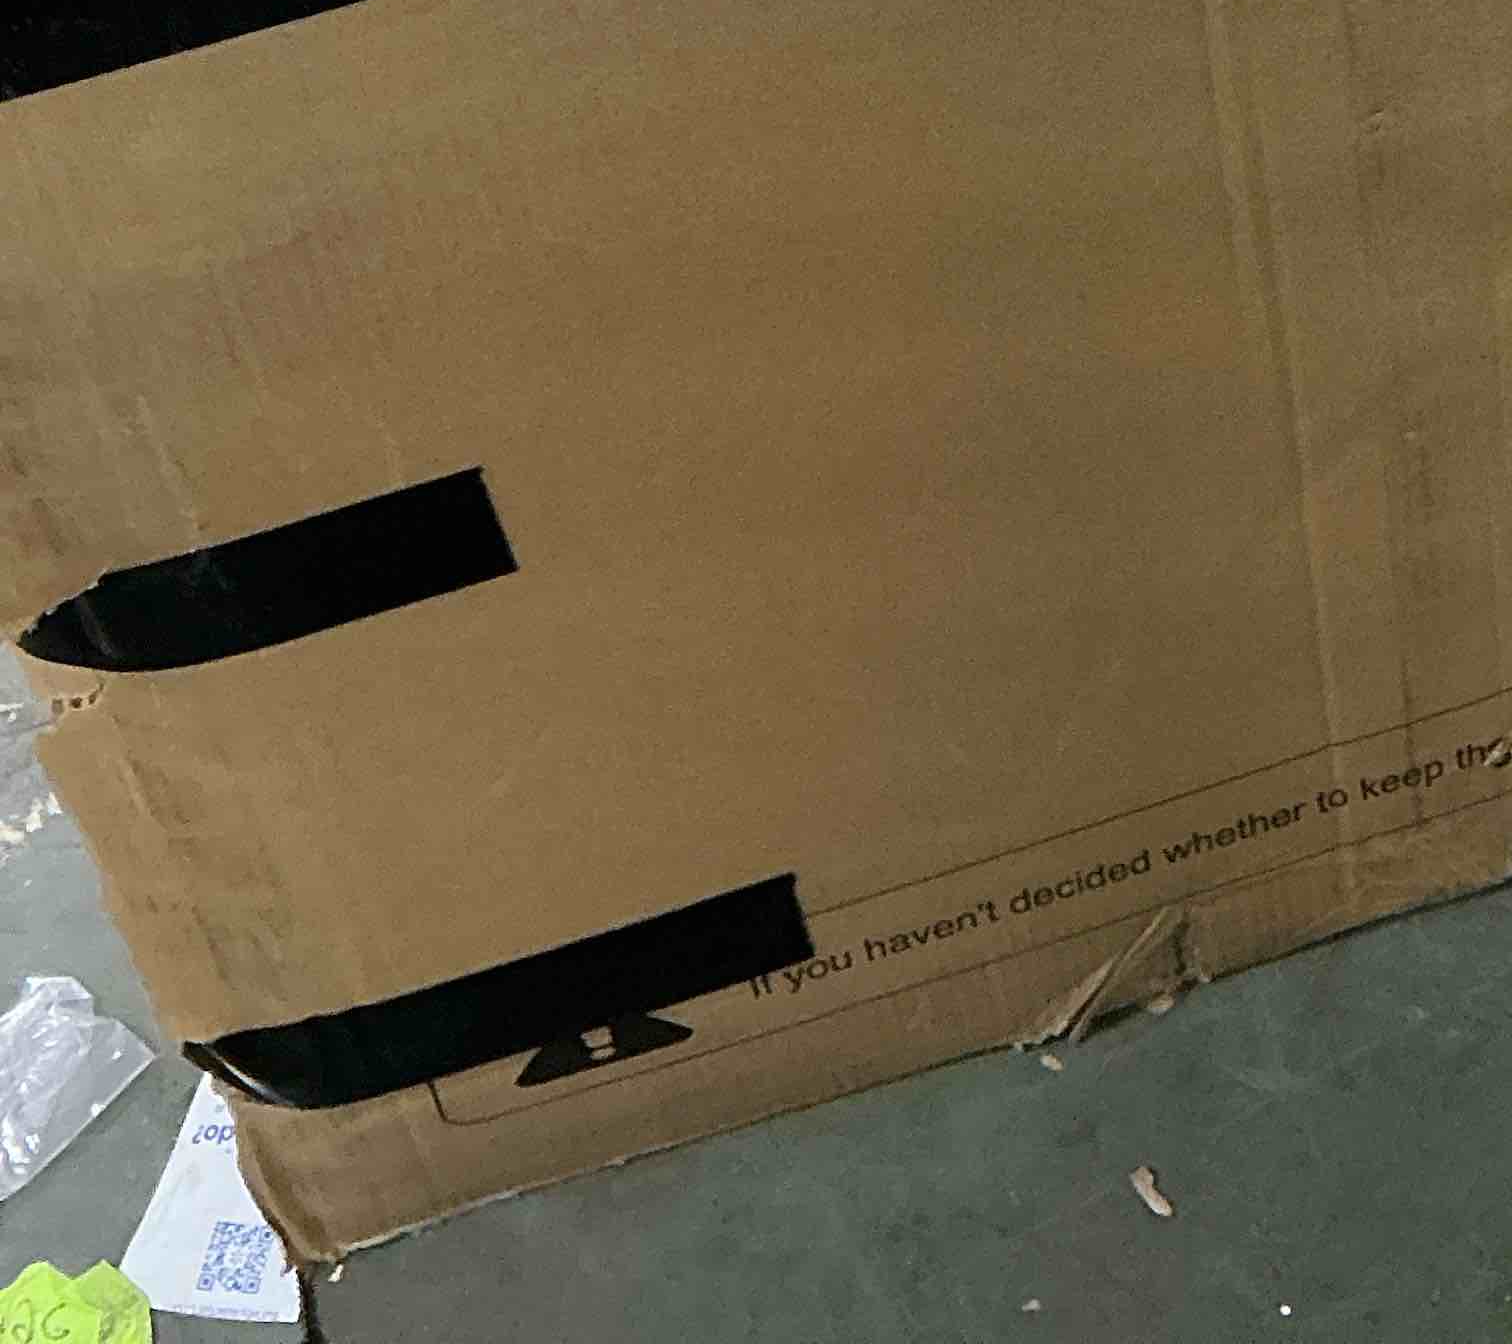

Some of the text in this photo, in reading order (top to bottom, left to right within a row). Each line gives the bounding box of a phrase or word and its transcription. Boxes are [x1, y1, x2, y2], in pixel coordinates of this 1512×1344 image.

[780, 946, 854, 996] you
[862, 897, 1002, 961] haven't
[1007, 846, 1154, 917] decided
[1159, 798, 1307, 867] whether
[1315, 782, 1350, 818] to
[1358, 757, 1447, 804] keep
